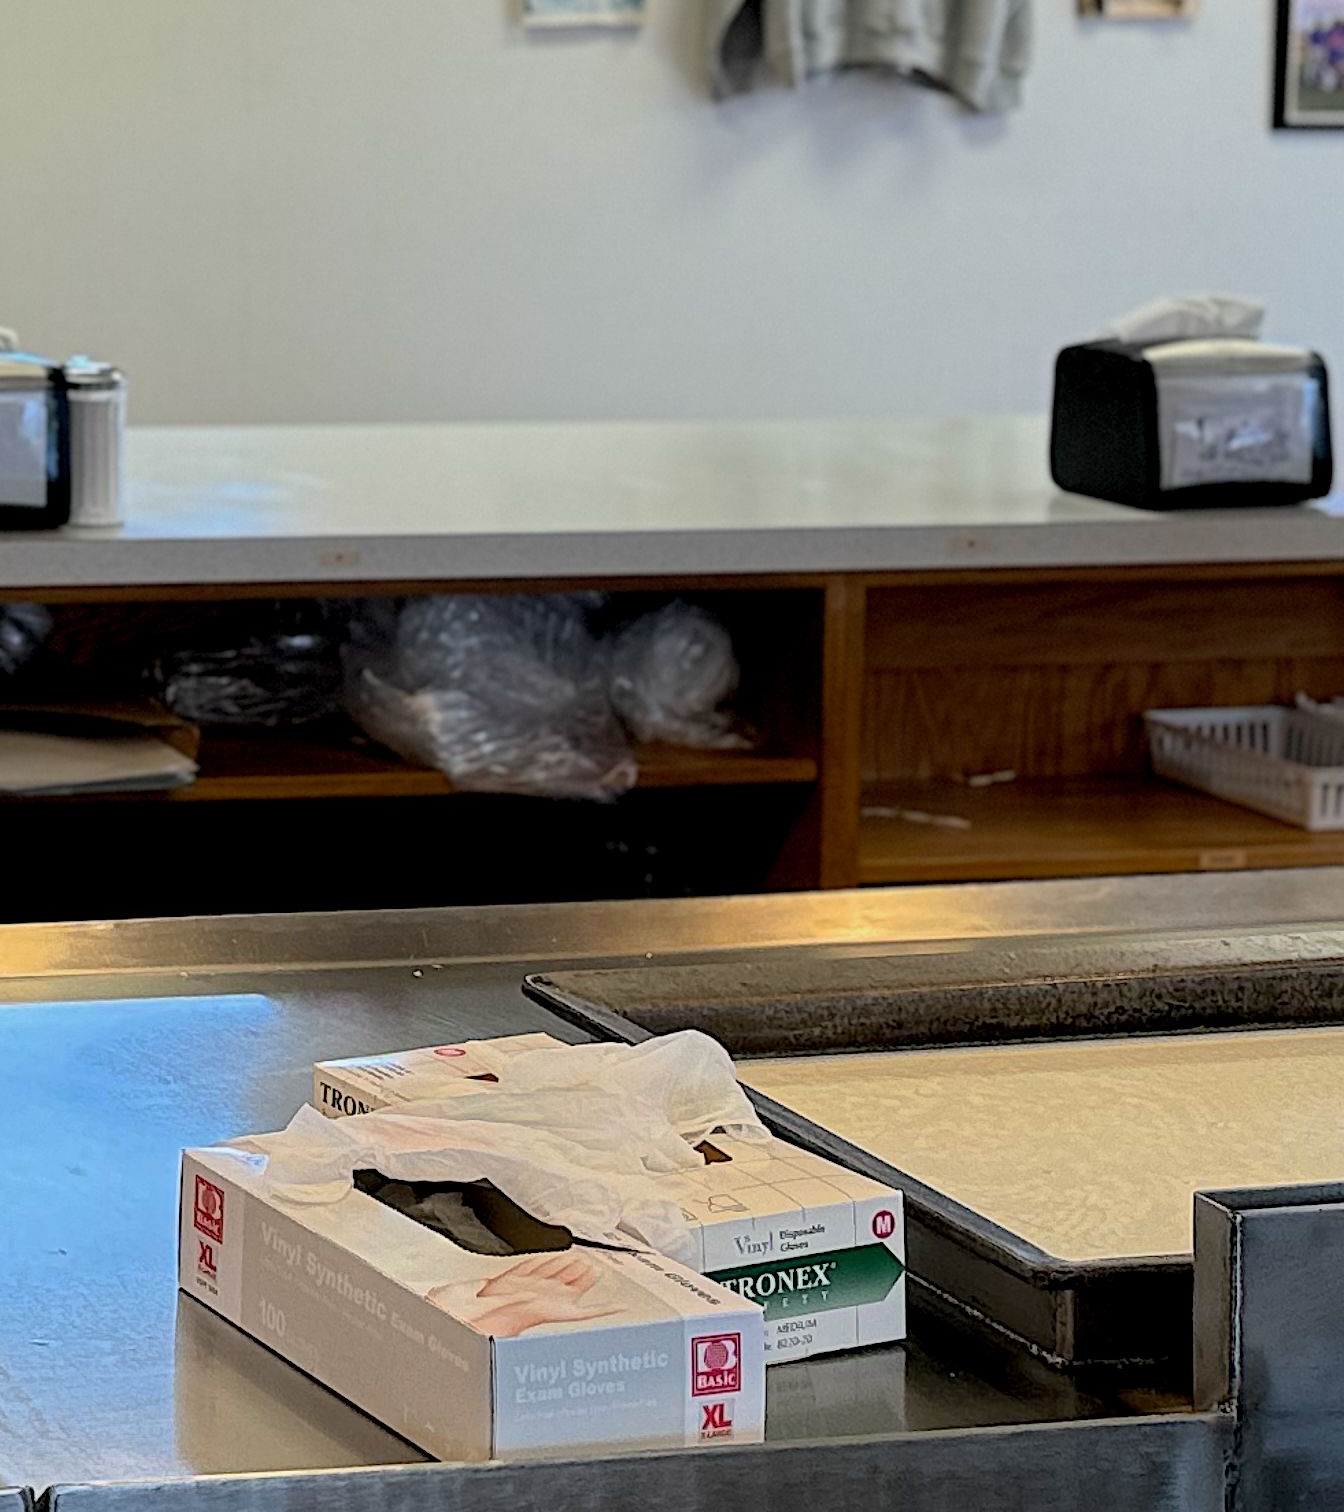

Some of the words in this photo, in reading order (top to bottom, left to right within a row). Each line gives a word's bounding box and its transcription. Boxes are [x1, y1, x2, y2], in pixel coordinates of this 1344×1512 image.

[320, 1082, 376, 1116] TRON
[876, 1215, 892, 1235] M
[199, 1240, 216, 1272] XL
[734, 1231, 774, 1257] Vinyl
[261, 1221, 302, 1267] Vinyl
[305, 1251, 387, 1321] Synthetic
[390, 1313, 425, 1345] Exam
[427, 1334, 471, 1373] Gloves
[260, 1299, 287, 1338] 100
[513, 1359, 567, 1386] Vinyl
[573, 1350, 669, 1379] Synthetic
[515, 1386, 562, 1404] Exam
[568, 1380, 626, 1399] Gloves
[702, 1403, 732, 1430] XL
